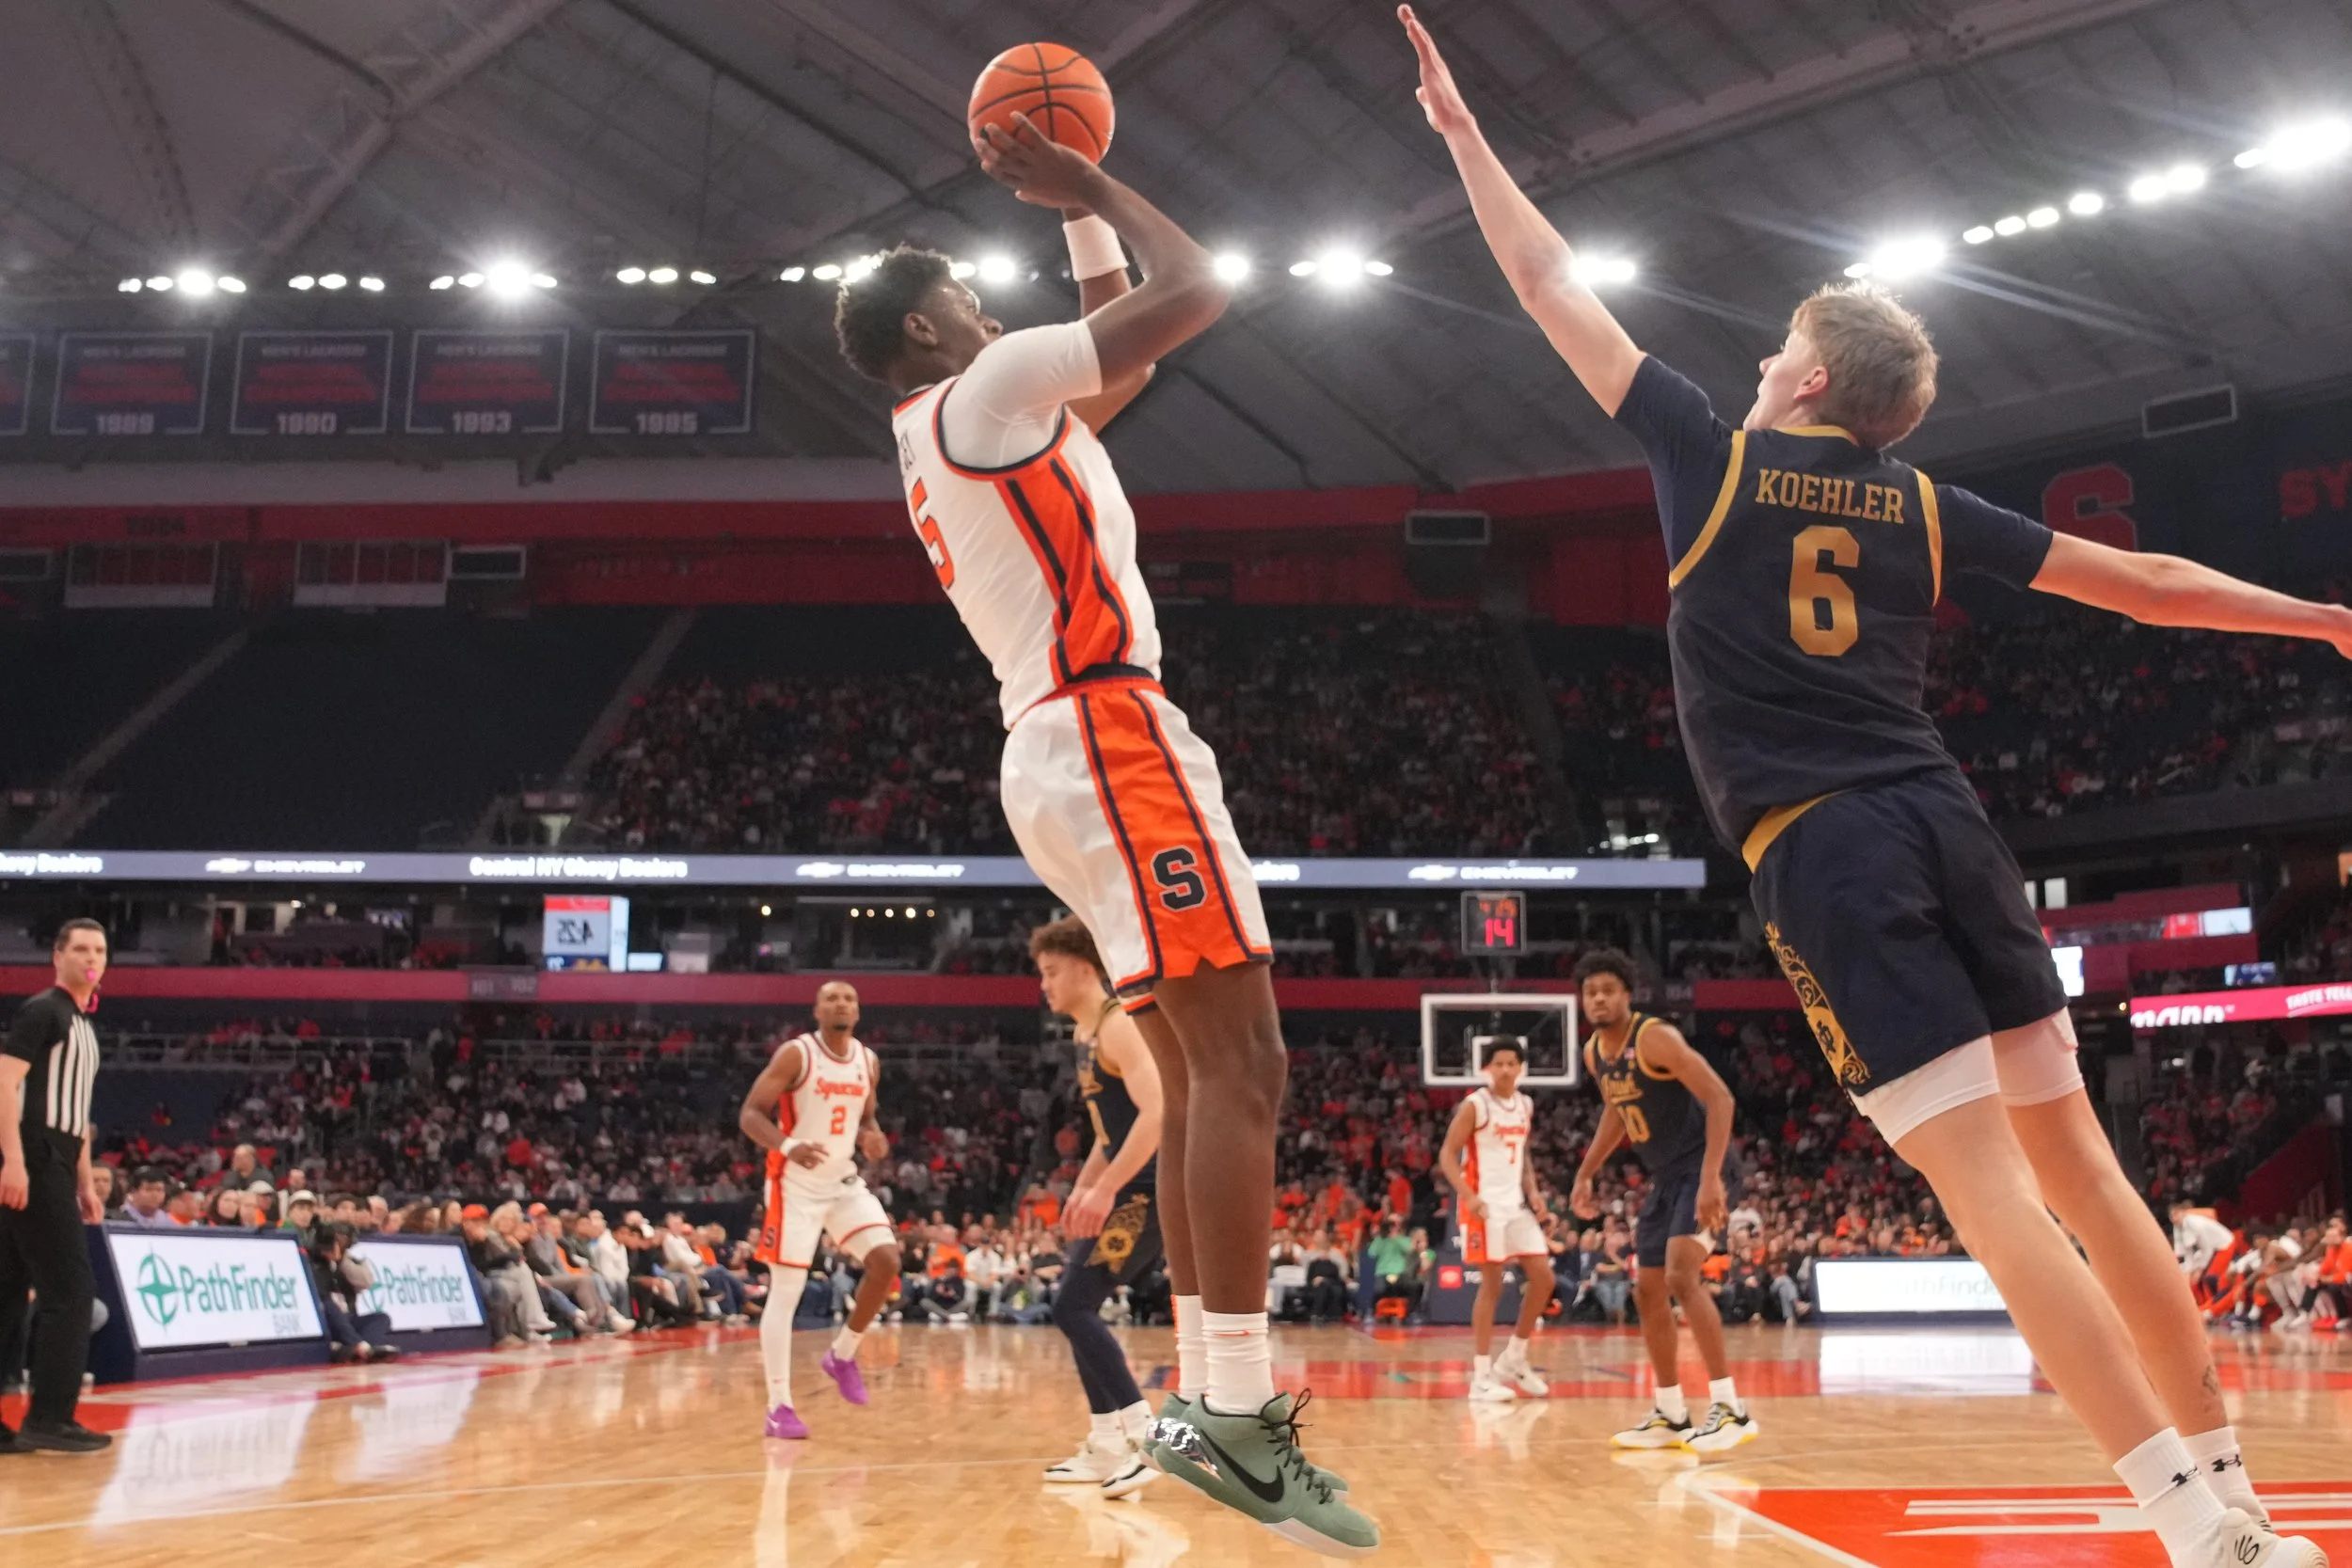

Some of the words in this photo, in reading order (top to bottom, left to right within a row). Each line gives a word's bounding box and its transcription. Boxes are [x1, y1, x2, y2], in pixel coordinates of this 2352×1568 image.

[1756, 468, 1905, 525] KOEHLER
[910, 476, 955, 591] 5
[1789, 525, 1860, 657] 6
[254, 860, 365, 873] CHEVROLET
[469, 857, 535, 877] Central
[536, 857, 564, 877] NY
[564, 857, 618, 880] Chevy
[619, 858, 688, 878] Dealers
[847, 863, 965, 878] CHEVROLET
[1150, 845, 1207, 912] S
[1460, 866, 1579, 880] CHEVROLET
[1485, 915, 1516, 948] 14
[830, 1105, 847, 1135] 2
[1505, 1142, 1516, 1164] 7
[179, 1260, 298, 1314] PathFinder
[383, 1262, 465, 1306] PathFinder
